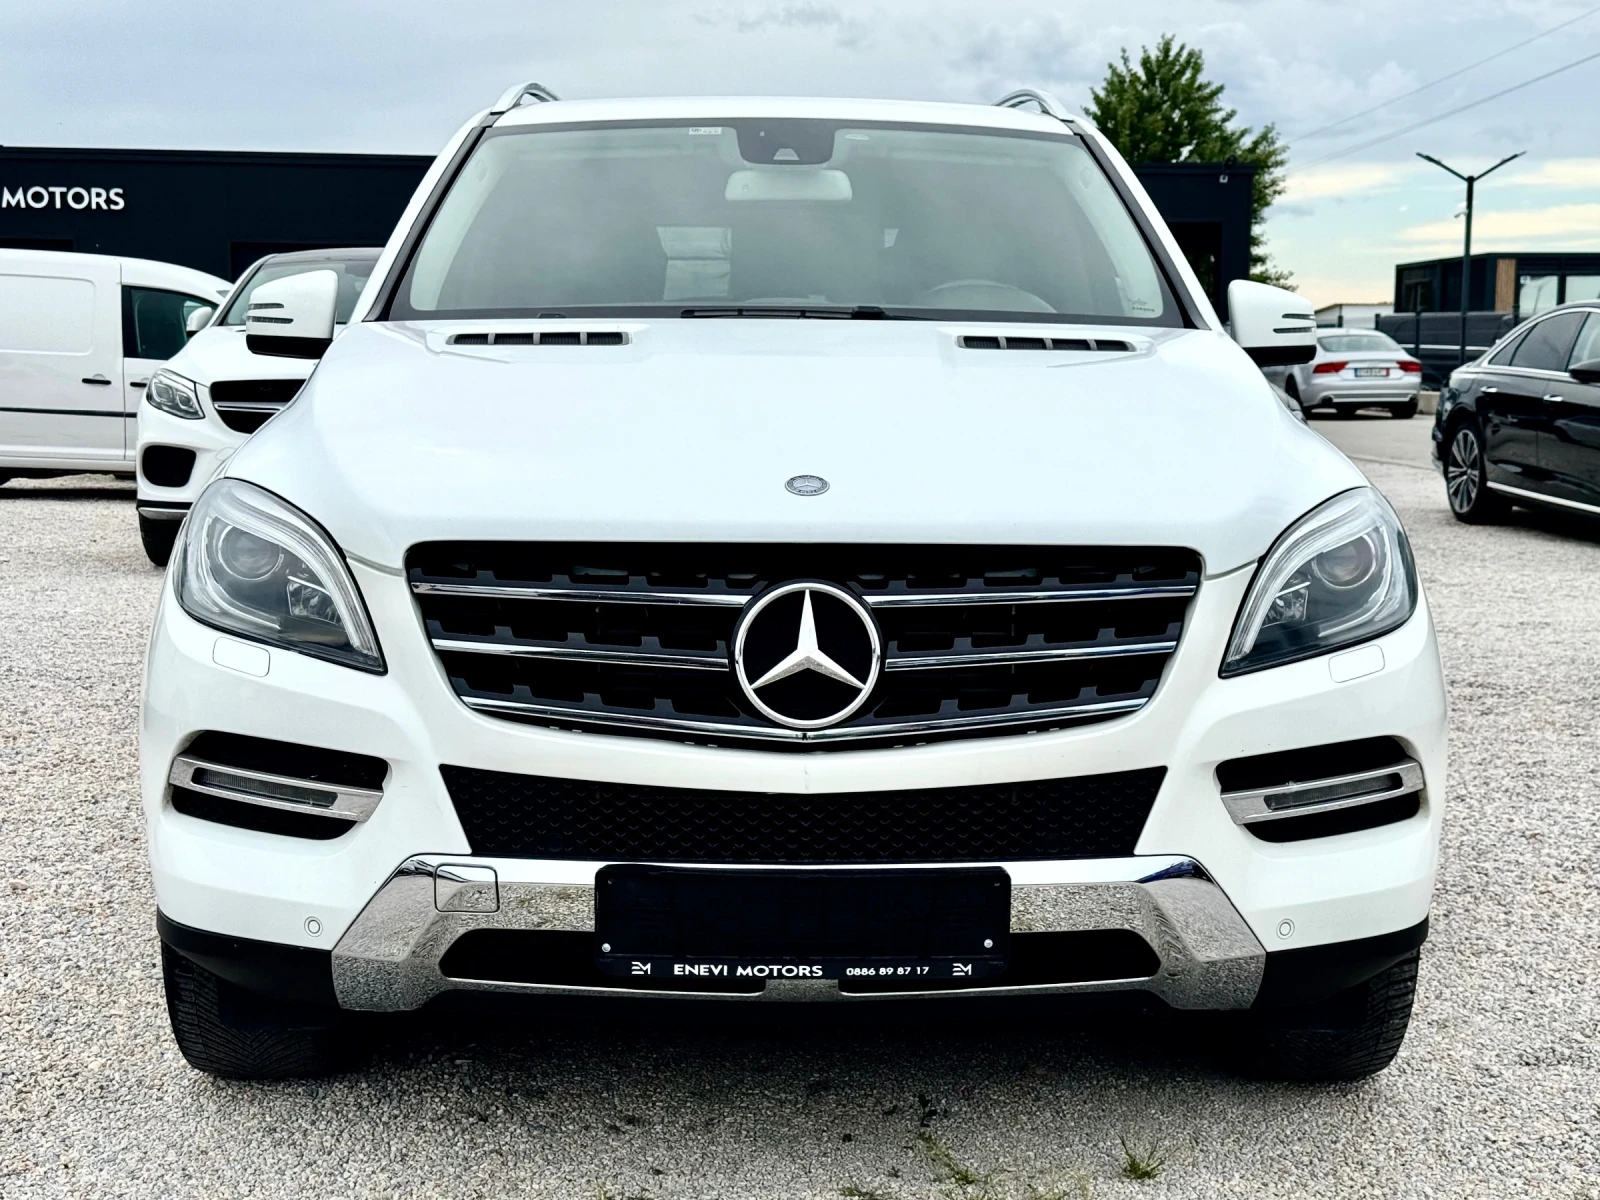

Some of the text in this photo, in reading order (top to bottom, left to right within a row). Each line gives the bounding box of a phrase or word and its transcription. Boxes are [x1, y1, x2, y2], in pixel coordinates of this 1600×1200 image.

[1, 186, 126, 211] MOTORS
[673, 963, 728, 977] ENEVI
[735, 964, 823, 978] MOTORS
[845, 966, 876, 977] 0886
[878, 966, 895, 977] 89
[896, 966, 912, 976] 87
[915, 966, 930, 976] 17
